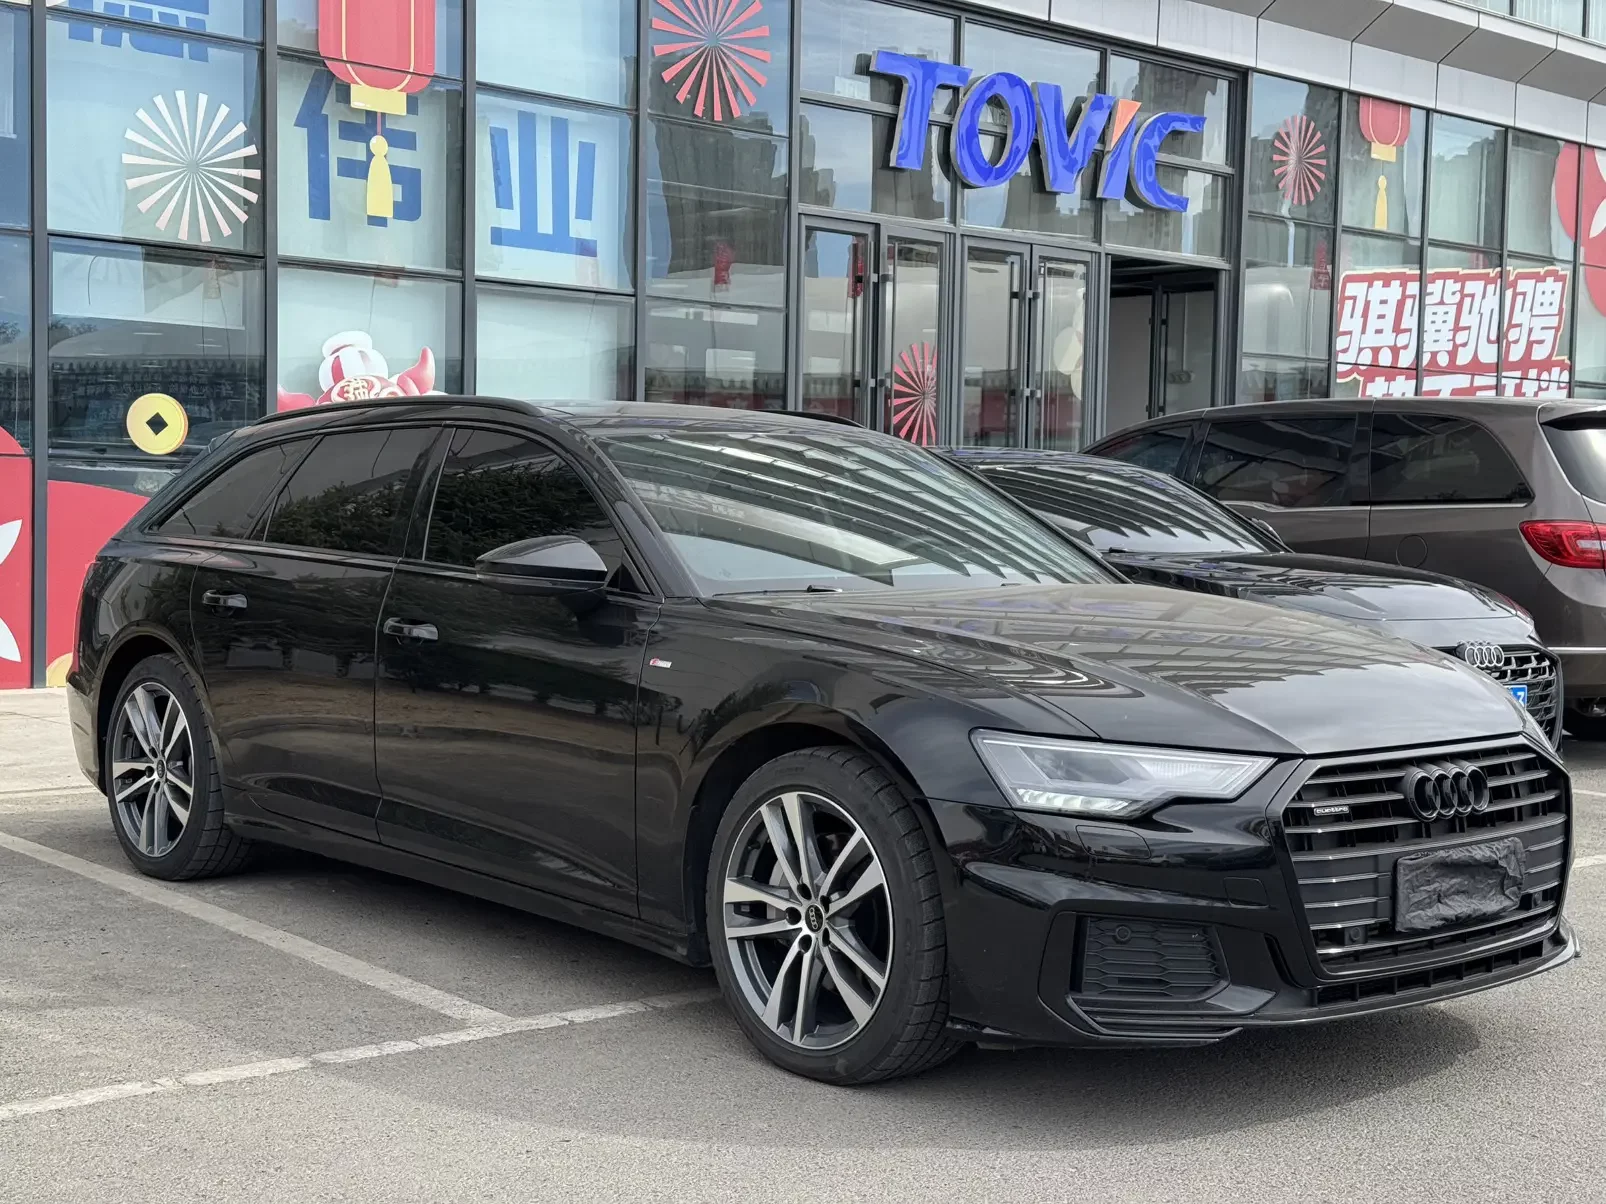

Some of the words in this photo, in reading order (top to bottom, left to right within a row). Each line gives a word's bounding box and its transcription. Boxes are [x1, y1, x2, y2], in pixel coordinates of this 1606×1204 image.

[293, 68, 598, 258] 伟业
[869, 50, 1206, 212] TOVIC
[1336, 276, 1564, 373] 骐骥驰骋
